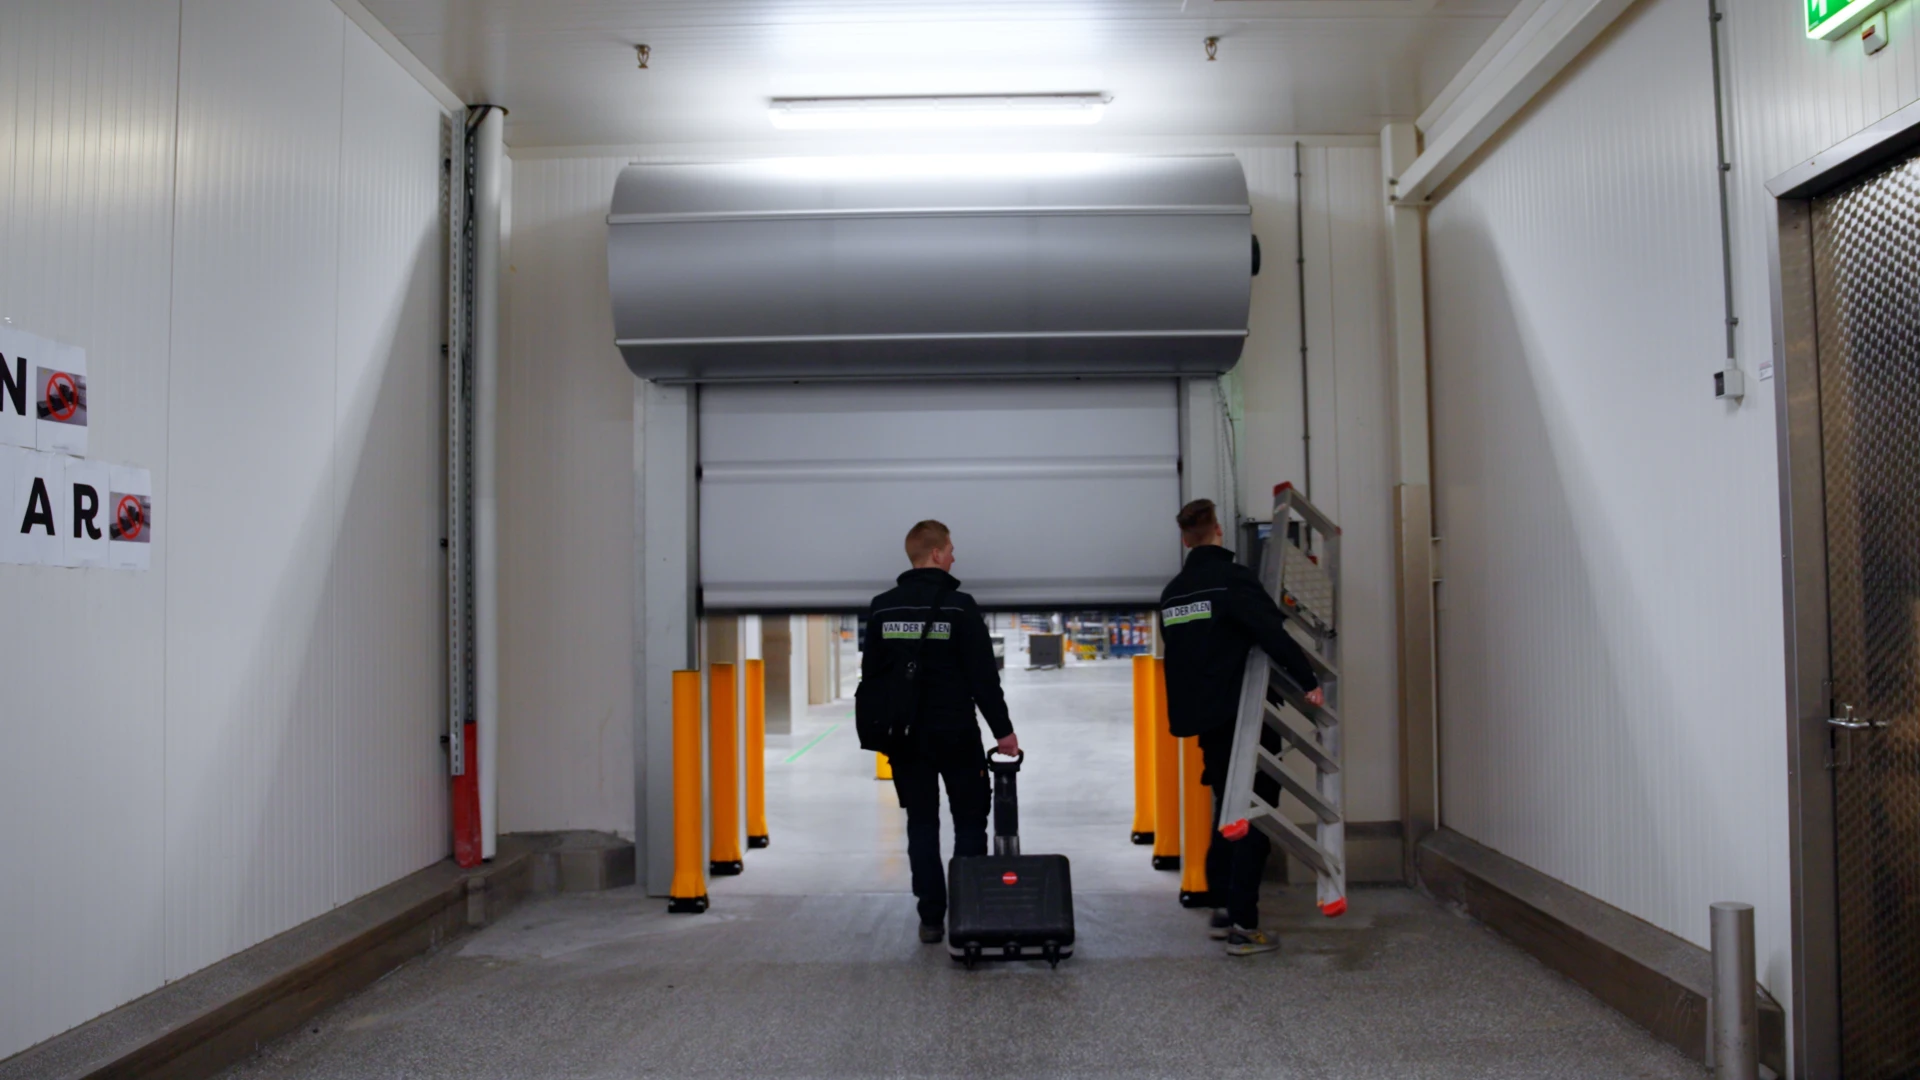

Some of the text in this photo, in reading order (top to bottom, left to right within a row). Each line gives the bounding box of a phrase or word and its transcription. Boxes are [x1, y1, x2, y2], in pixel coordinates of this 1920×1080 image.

[0, 352, 27, 416] N
[1175, 606, 1189, 616] DER
[883, 623, 900, 632] VAN
[903, 623, 919, 632] DER
